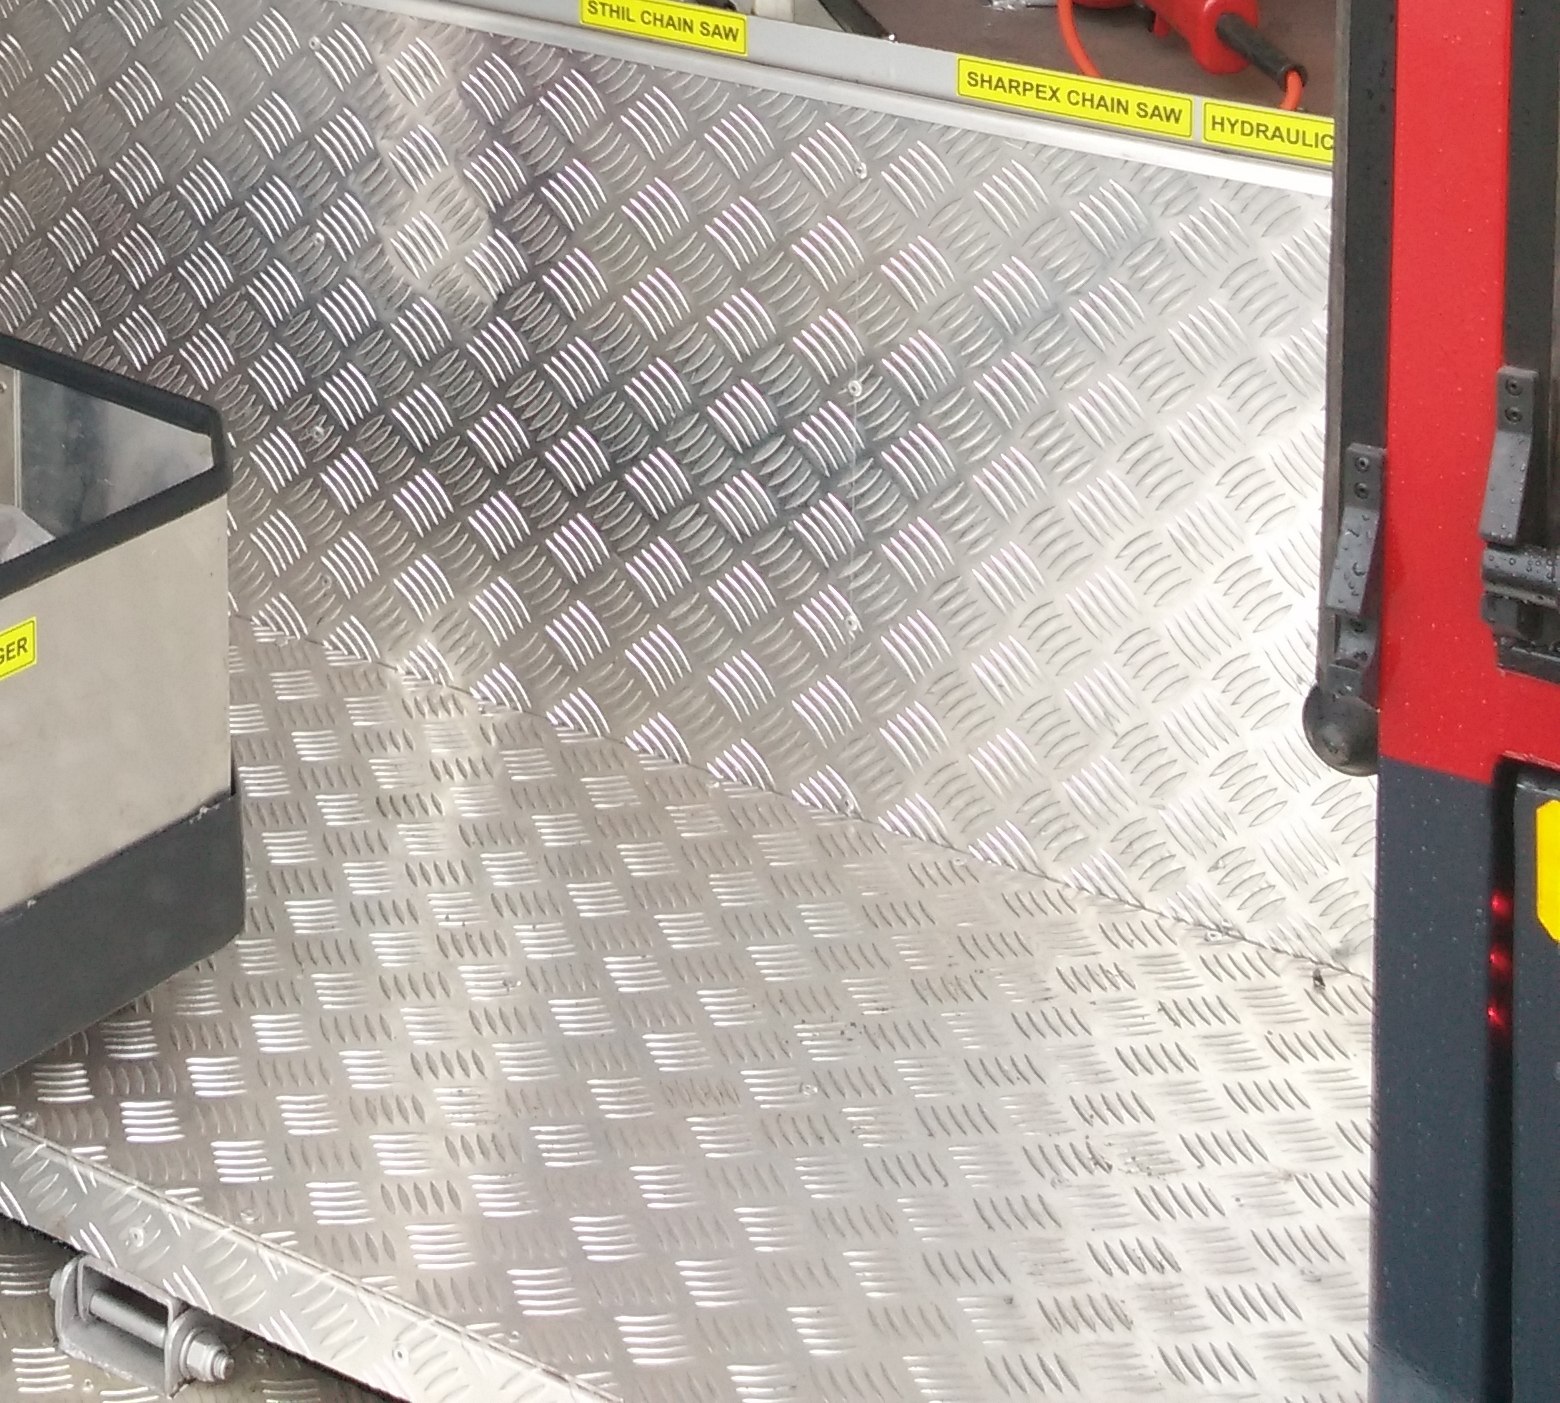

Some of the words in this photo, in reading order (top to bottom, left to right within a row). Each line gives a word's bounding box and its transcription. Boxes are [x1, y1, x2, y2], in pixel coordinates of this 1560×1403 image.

[587, 0, 636, 23] STHIL
[640, 9, 694, 34] CHAIN
[699, 21, 740, 43] SAW
[966, 71, 1061, 104] SHARPEX
[1067, 88, 1129, 117] CHAIN
[1135, 100, 1183, 125] SAW
[1211, 114, 1334, 152] HYDRAULIC
